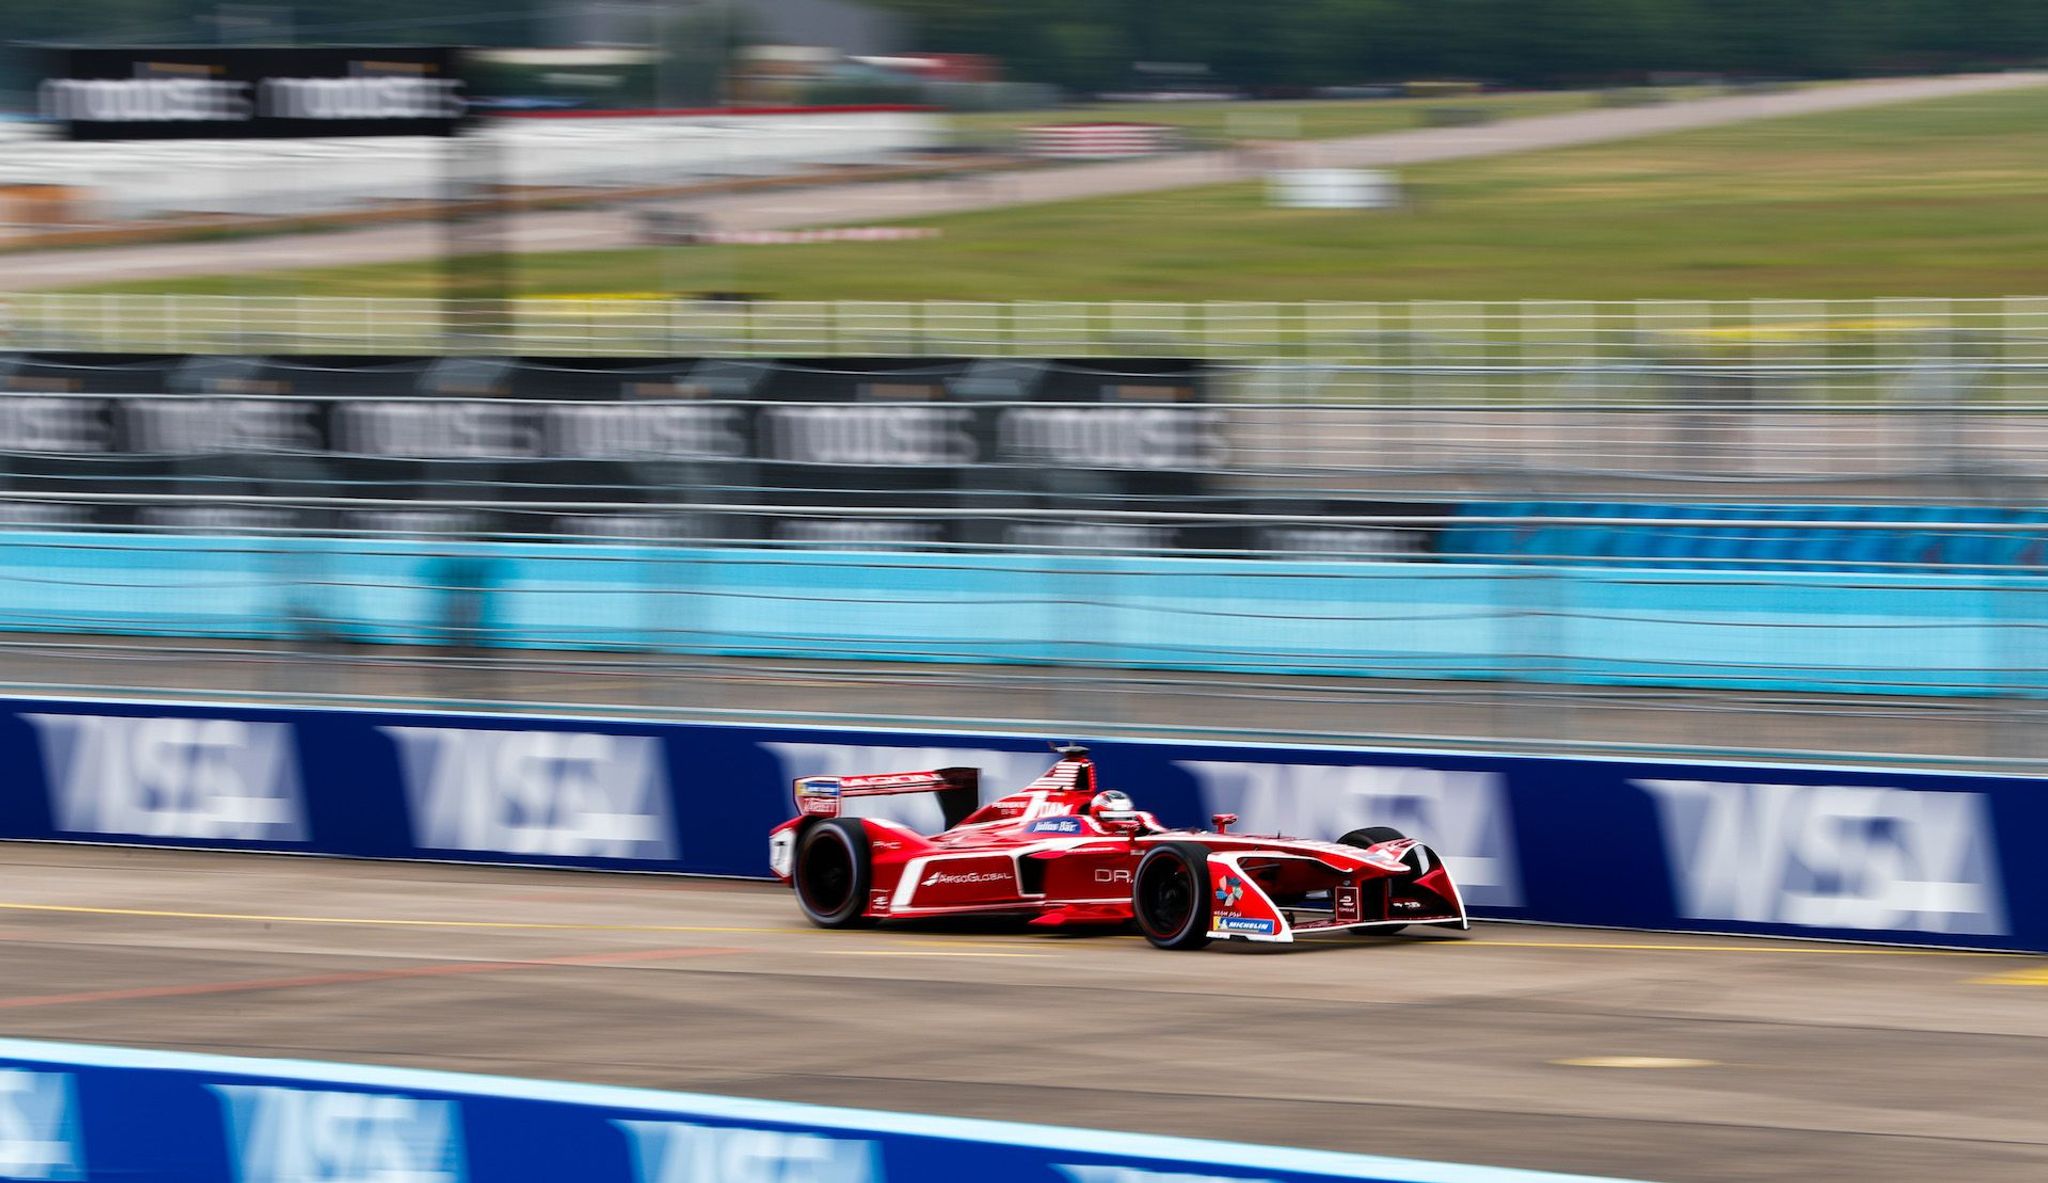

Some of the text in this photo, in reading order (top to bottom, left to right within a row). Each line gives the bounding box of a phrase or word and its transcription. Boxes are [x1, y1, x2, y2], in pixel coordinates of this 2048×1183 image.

[1033, 820, 1059, 832] Julius
[1094, 868, 1134, 884] DR
[1228, 921, 1269, 930] MICHELIN
